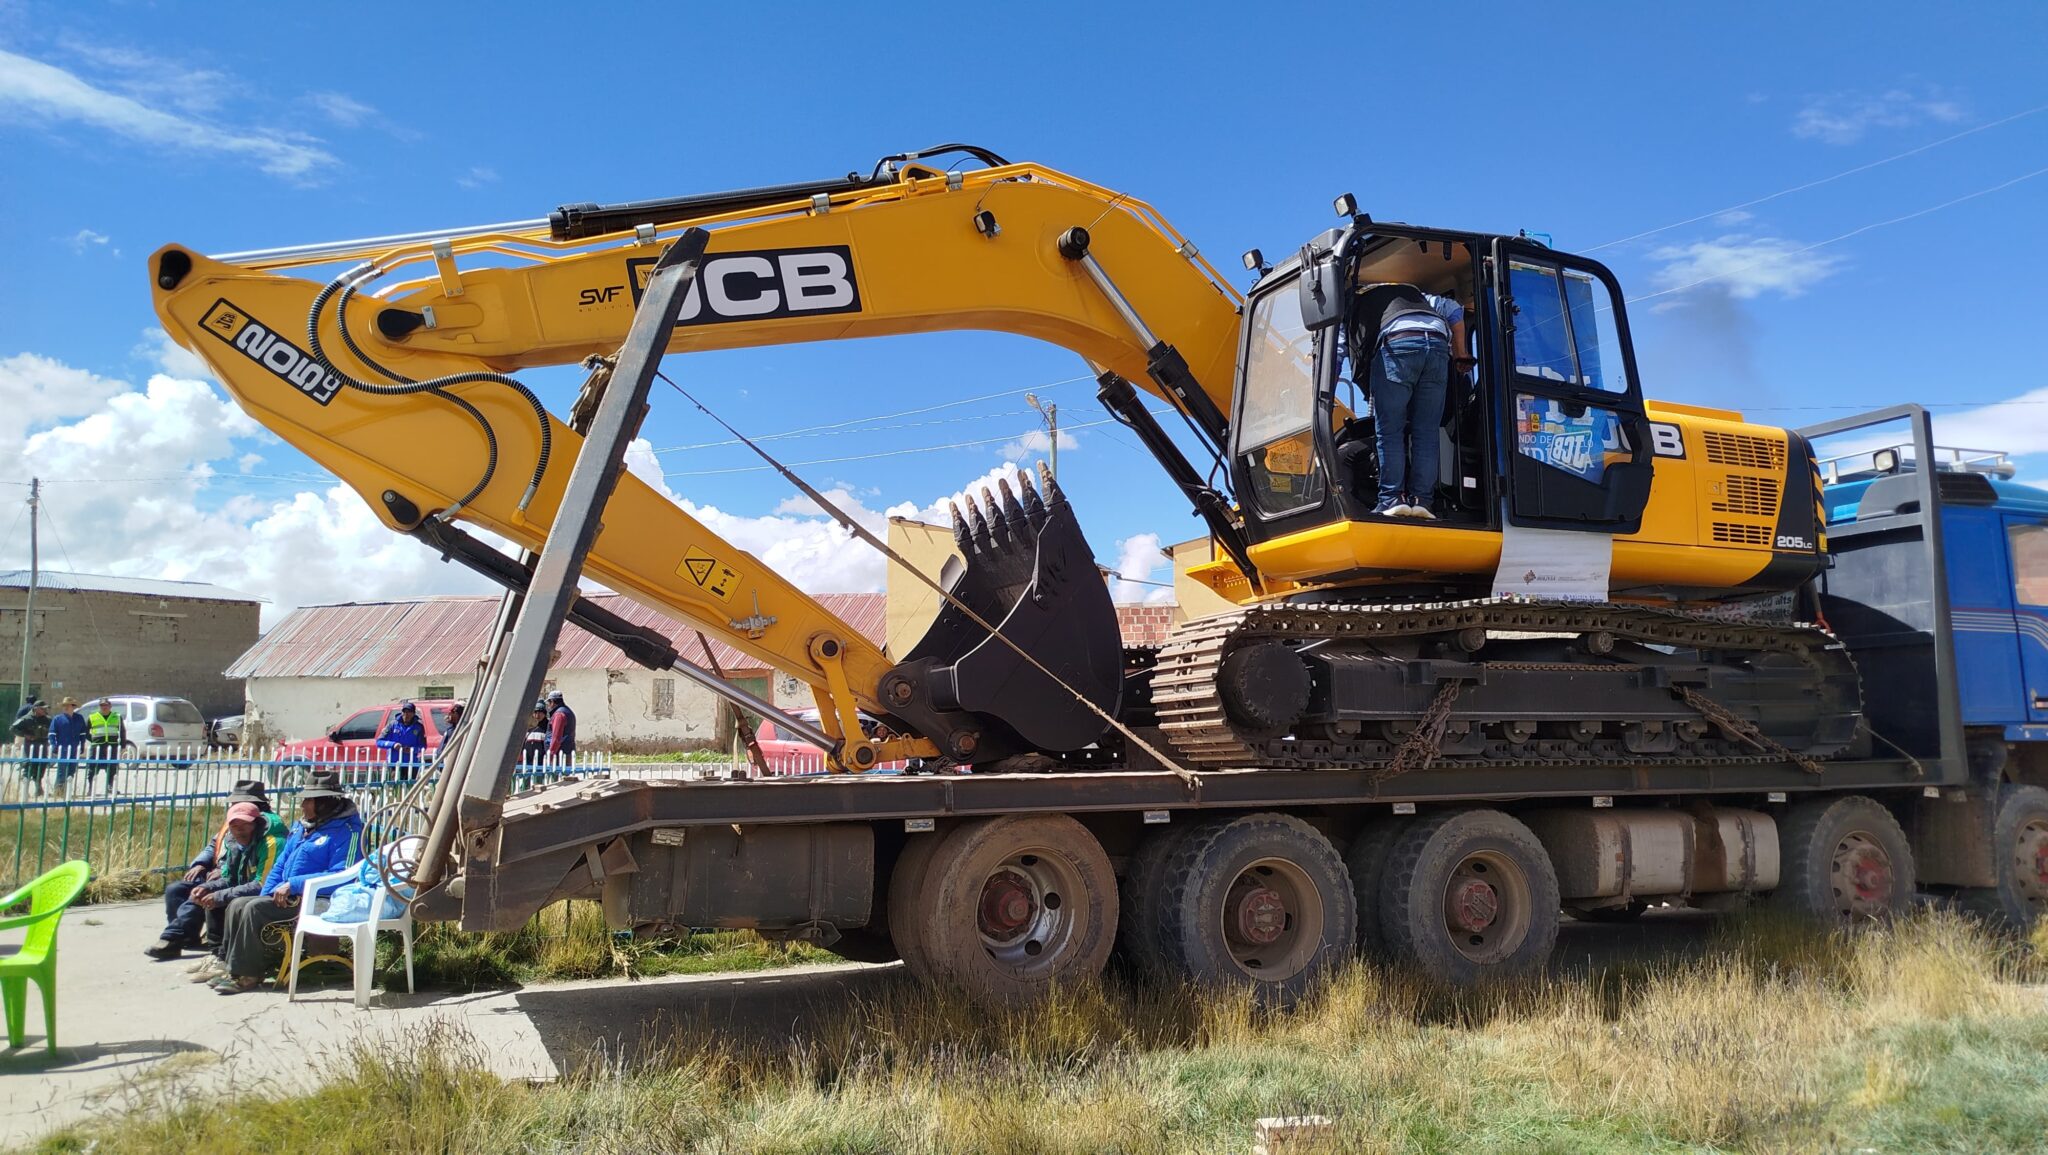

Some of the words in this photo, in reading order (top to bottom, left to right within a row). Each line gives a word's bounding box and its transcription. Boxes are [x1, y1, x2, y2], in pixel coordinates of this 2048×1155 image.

[579, 286, 625, 306] SVF
[215, 312, 237, 330] JCB
[236, 323, 325, 391] 205
